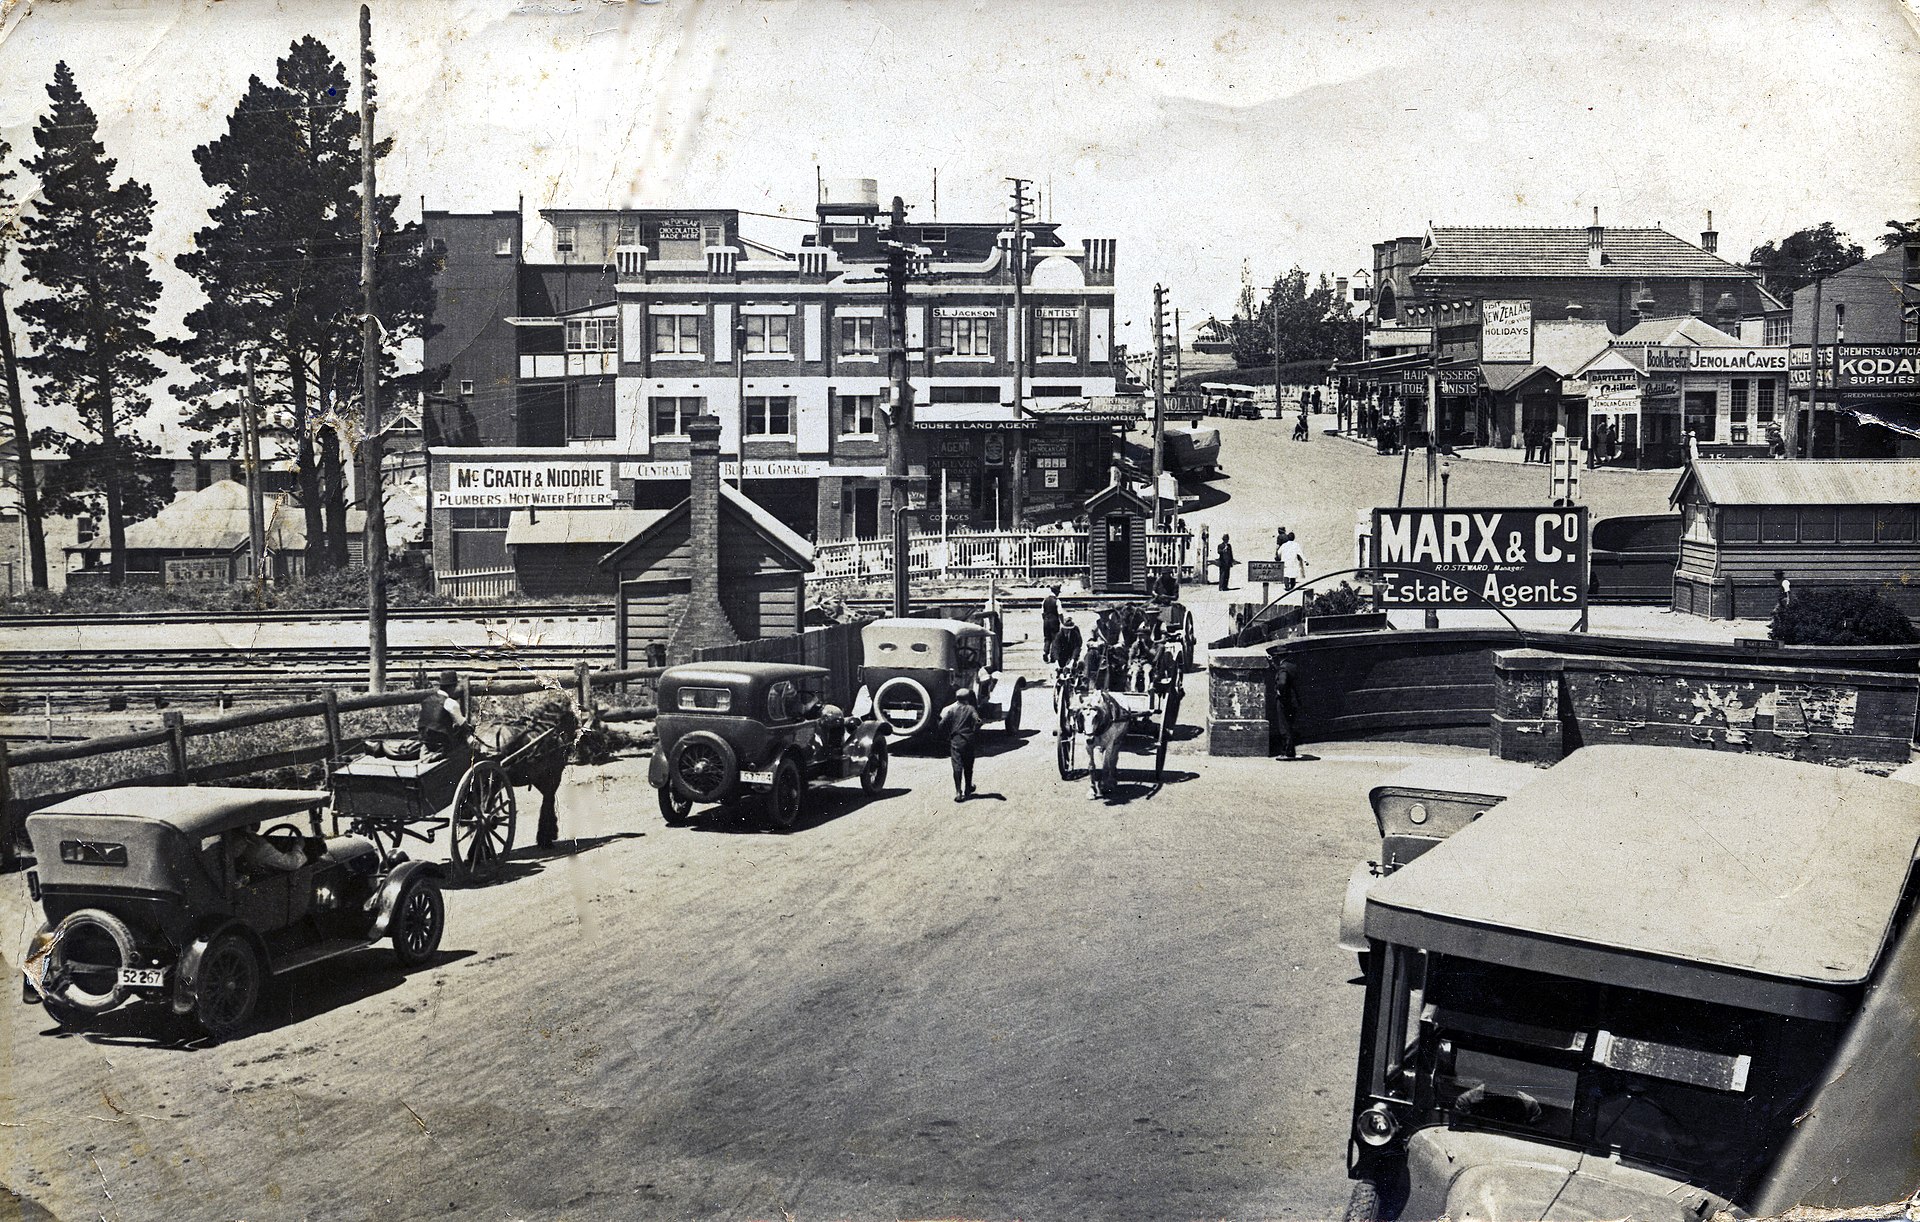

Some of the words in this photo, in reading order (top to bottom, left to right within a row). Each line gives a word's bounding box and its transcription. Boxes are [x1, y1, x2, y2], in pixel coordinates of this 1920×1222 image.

[1036, 309, 1078, 317] DENTIST
[1484, 310, 1499, 326] NEW
[1499, 302, 1531, 322] ZEALAND
[1485, 328, 1529, 336] HOLIDAYS
[1838, 347, 1881, 356] CHEMISTS
[1881, 348, 1887, 356] &
[1647, 350, 1664, 368] Book
[637, 465, 682, 477] CENTRAL
[767, 463, 810, 476] GARAGE
[484, 469, 532, 488] GRATH
[535, 472, 543, 487] &
[547, 469, 604, 488] NIDDRIE
[440, 494, 501, 506] PLUMBERS
[509, 493, 529, 505] HOT
[531, 493, 565, 504] WATER
[567, 493, 613, 504] FITTERS
[1380, 513, 1503, 563] MARX
[1505, 531, 1528, 563] &
[1382, 573, 1469, 603] Estate
[1481, 573, 1578, 608] Agents
